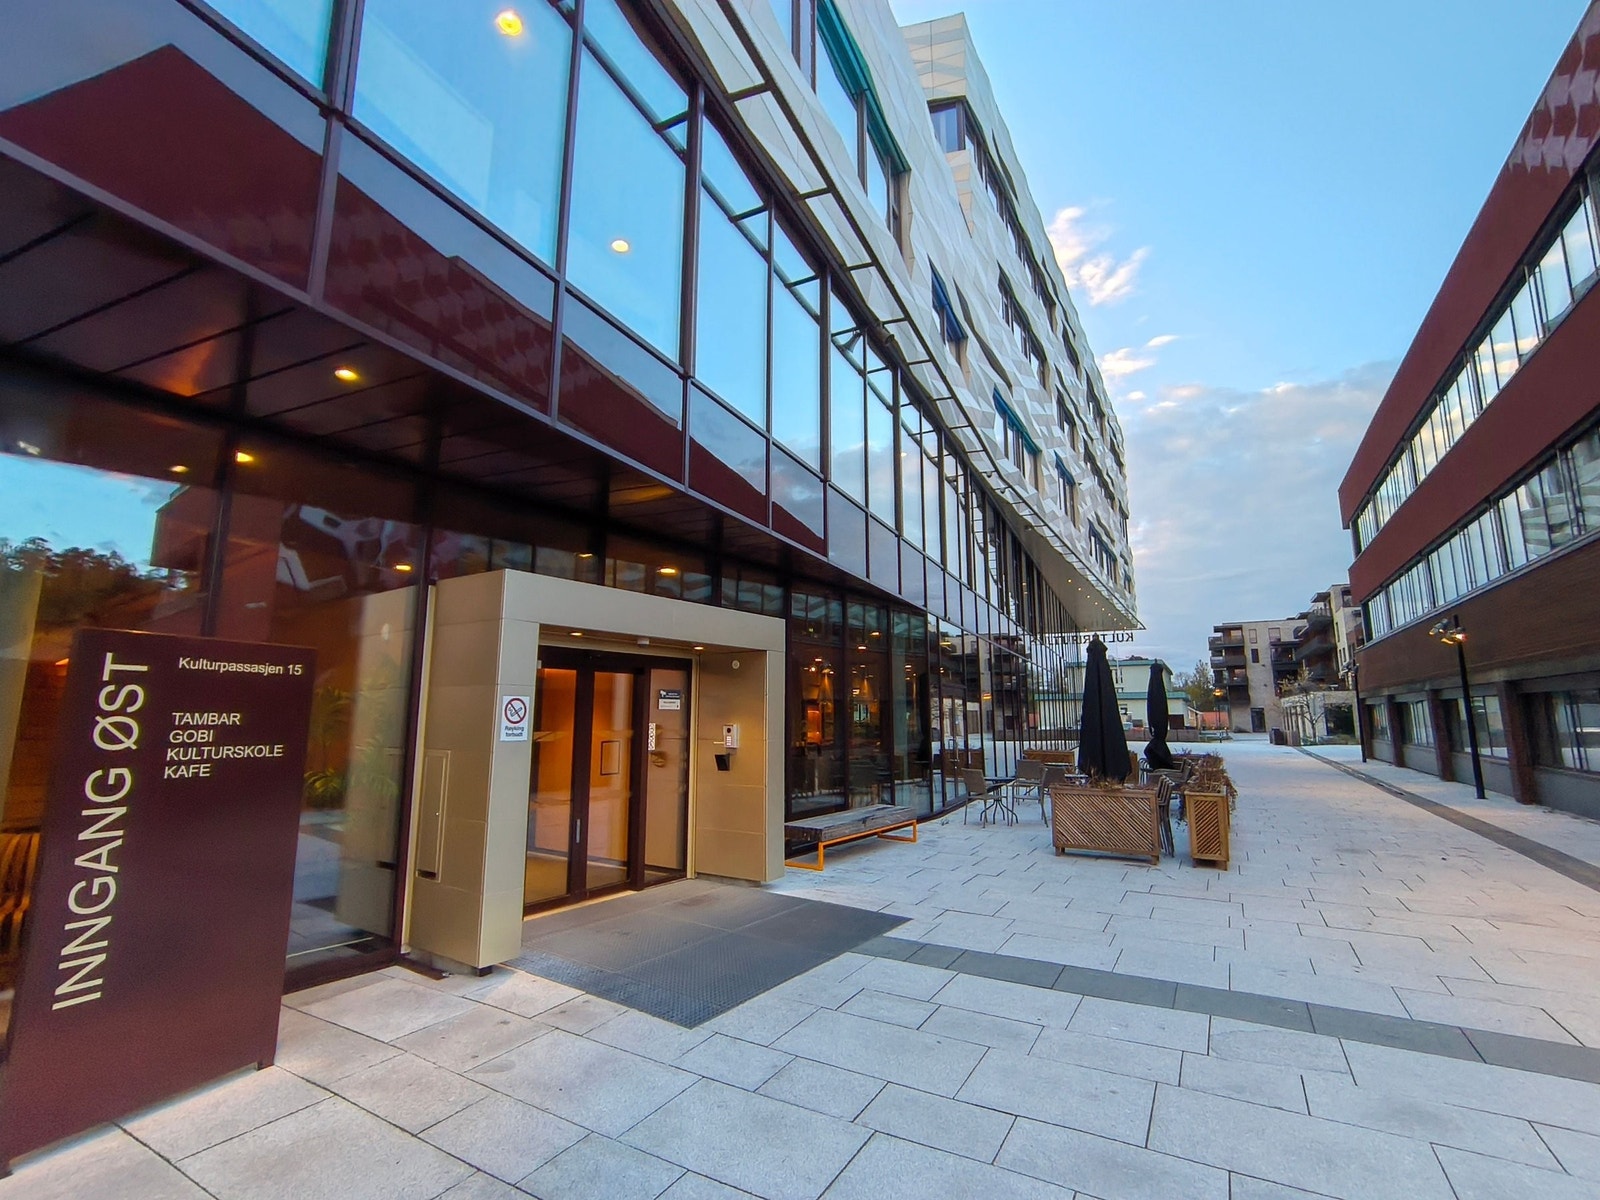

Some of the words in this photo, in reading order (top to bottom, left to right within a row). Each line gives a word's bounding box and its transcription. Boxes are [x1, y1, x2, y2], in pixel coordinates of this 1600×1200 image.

[178, 656, 284, 676] Kulturpassasjen
[287, 664, 303, 676] 15
[172, 712, 241, 726] TAMBAR
[169, 729, 214, 744] GOBI
[166, 744, 284, 761] KULTURSKOLE
[163, 763, 211, 779] KAFE
[52, 767, 132, 1011] INNGANG
[92, 652, 149, 751] ØST
